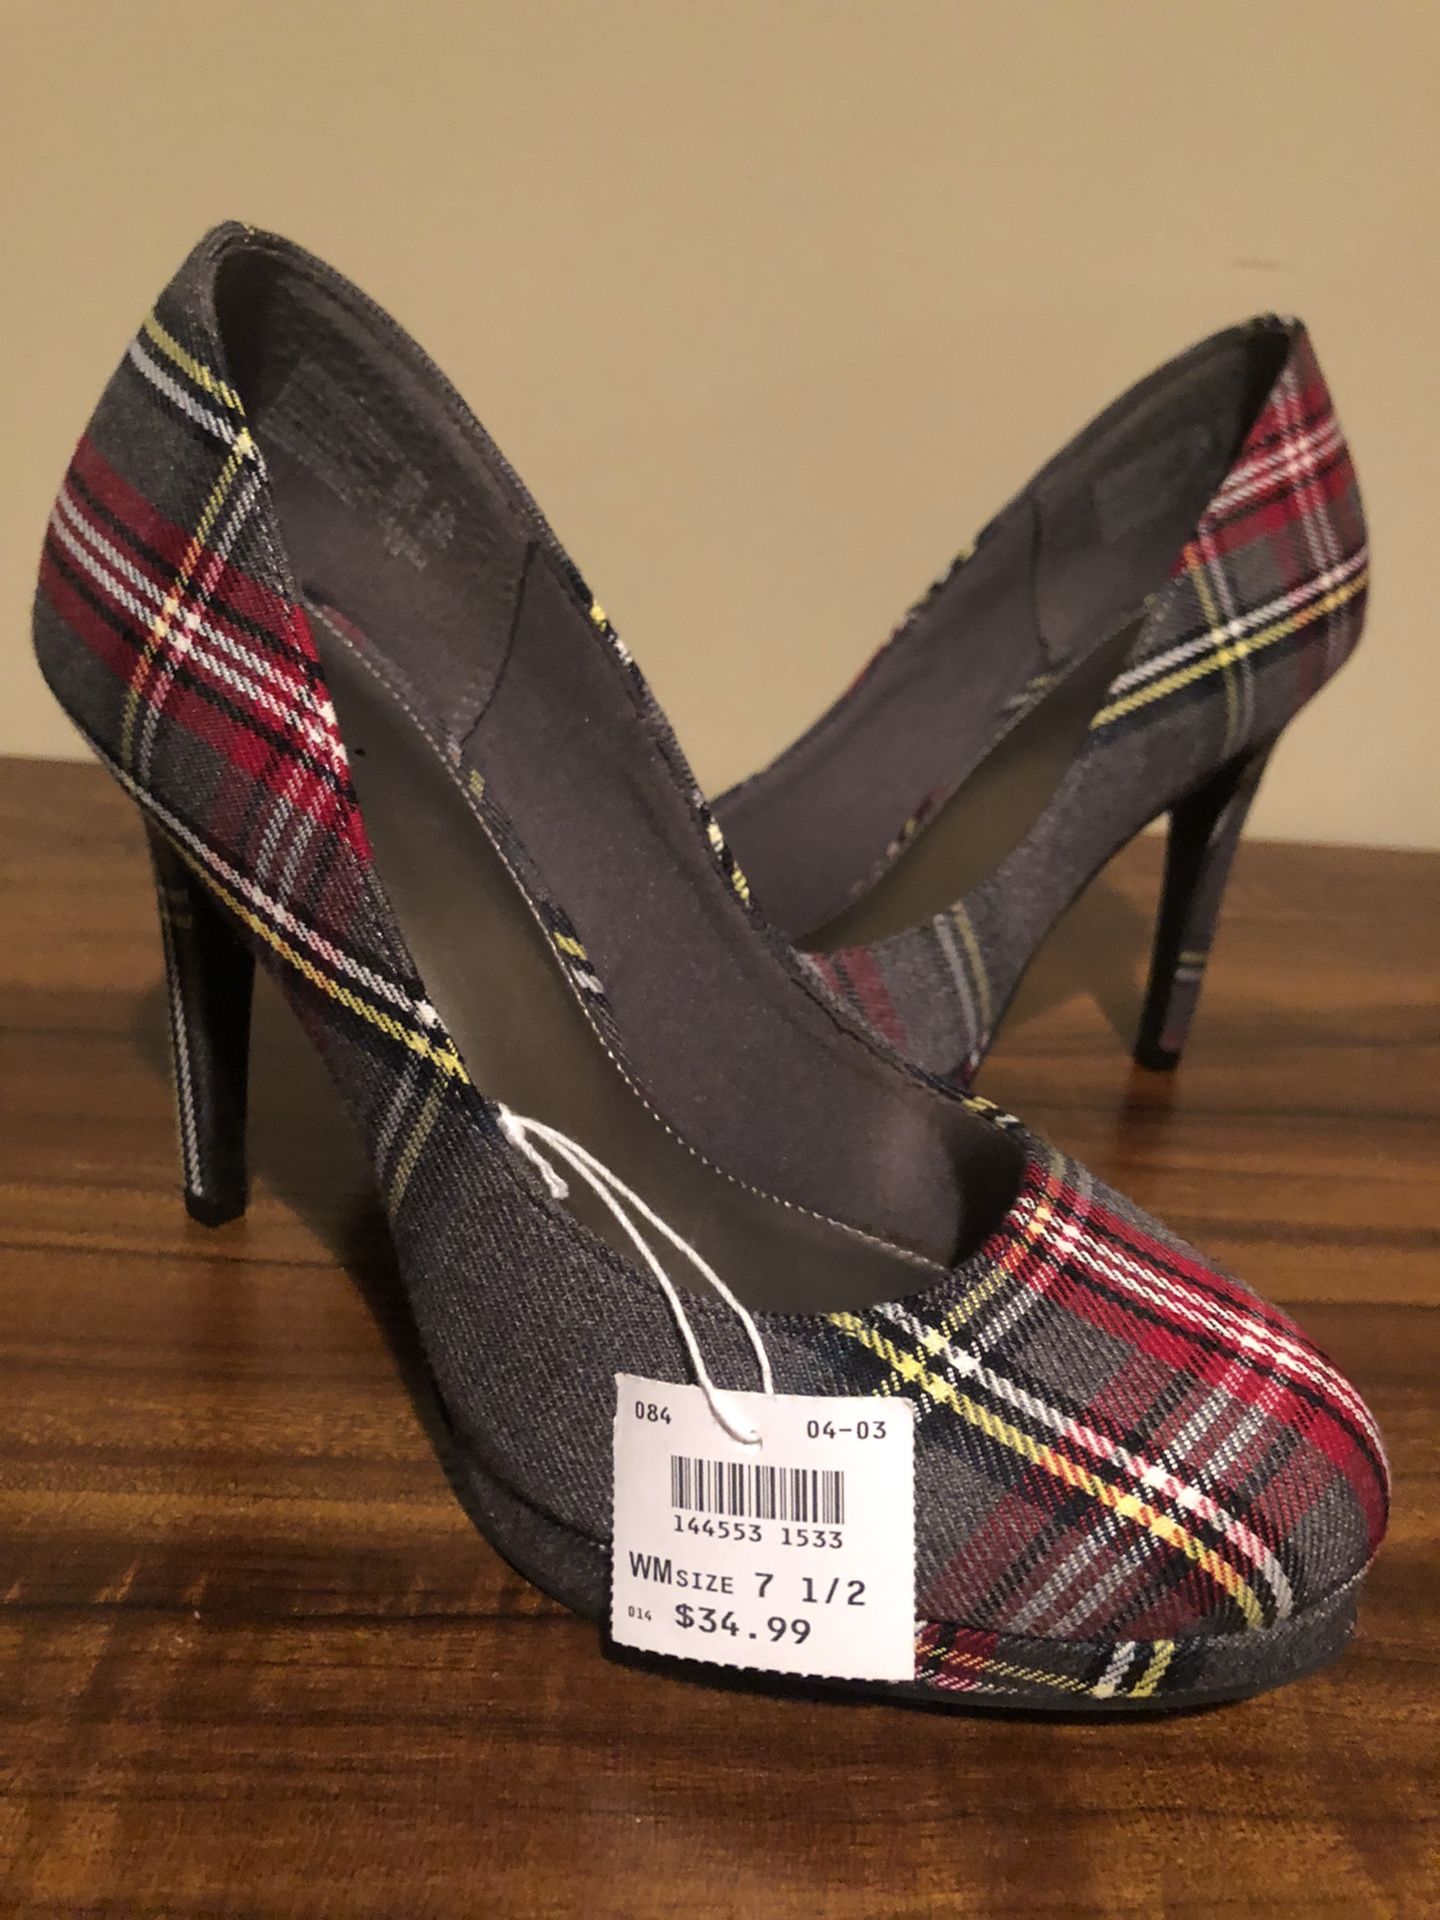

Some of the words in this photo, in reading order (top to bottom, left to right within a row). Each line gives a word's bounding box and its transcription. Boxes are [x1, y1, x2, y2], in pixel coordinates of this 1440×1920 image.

[634, 1400, 673, 1425] 084
[806, 1419, 888, 1440] 04-03
[673, 1513, 763, 1543] 144553
[780, 1526, 844, 1550] 1533
[754, 1571, 774, 1598] 7
[801, 1576, 866, 1607] 1/2
[627, 1604, 653, 1622] 014
[674, 1601, 812, 1645] $34.99
